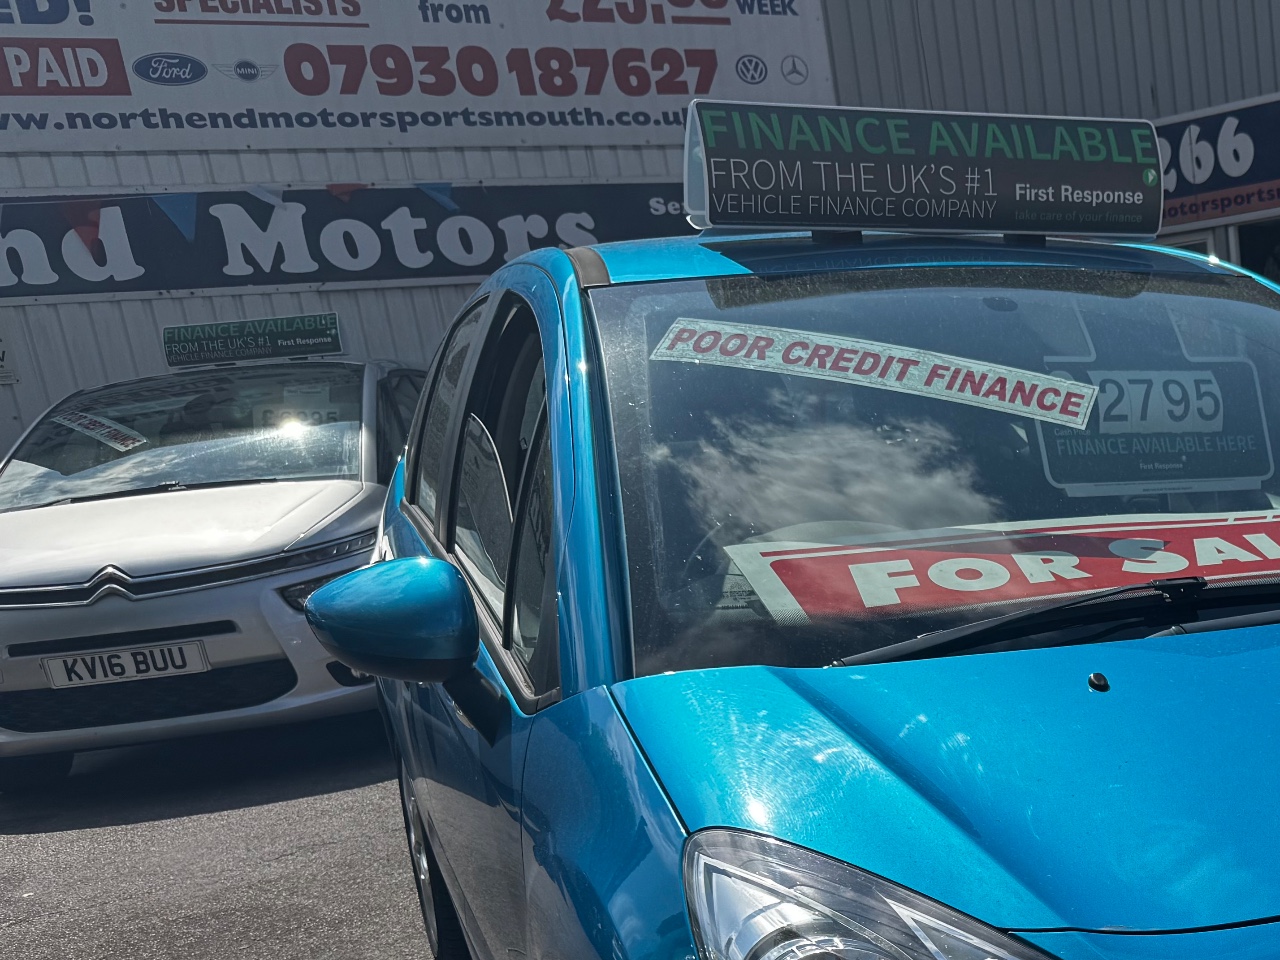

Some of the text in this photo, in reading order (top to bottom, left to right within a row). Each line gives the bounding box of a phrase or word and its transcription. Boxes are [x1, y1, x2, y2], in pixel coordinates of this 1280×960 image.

[418, 0, 491, 25] from
[735, 0, 799, 16] WEEK
[2, 46, 108, 88] PAID
[149, 57, 193, 80] Ford
[236, 67, 258, 75] MINI
[283, 42, 719, 97] 07930 187627
[701, 110, 1158, 164] FINANCE AVAILABLE
[711, 158, 998, 196] FROM THE UK'S #1
[649, 197, 690, 216] Se
[712, 193, 997, 219] VEHICLE FINANCE COMPANY
[1015, 184, 1144, 207] First Response
[1015, 209, 1143, 225] take care of your finance
[209, 201, 598, 277] Motors
[164, 315, 337, 342] FINANCE AVAILABLE
[165, 342, 199, 355] FROM
[201, 340, 226, 351] THE
[258, 336, 272, 347] #1
[278, 336, 332, 347] First Response
[167, 347, 272, 363] VEHICLE FINANCE COMPANY
[666, 327, 1086, 419] POOR CREDIT FINANCE
[1099, 378, 1221, 423] 2795
[1056, 435, 1256, 456] FINANCE AVAILABLE HERE
[1154, 462, 1183, 471] Response
[848, 549, 1093, 608] FOR
[62, 646, 188, 682] KV16 BUU
